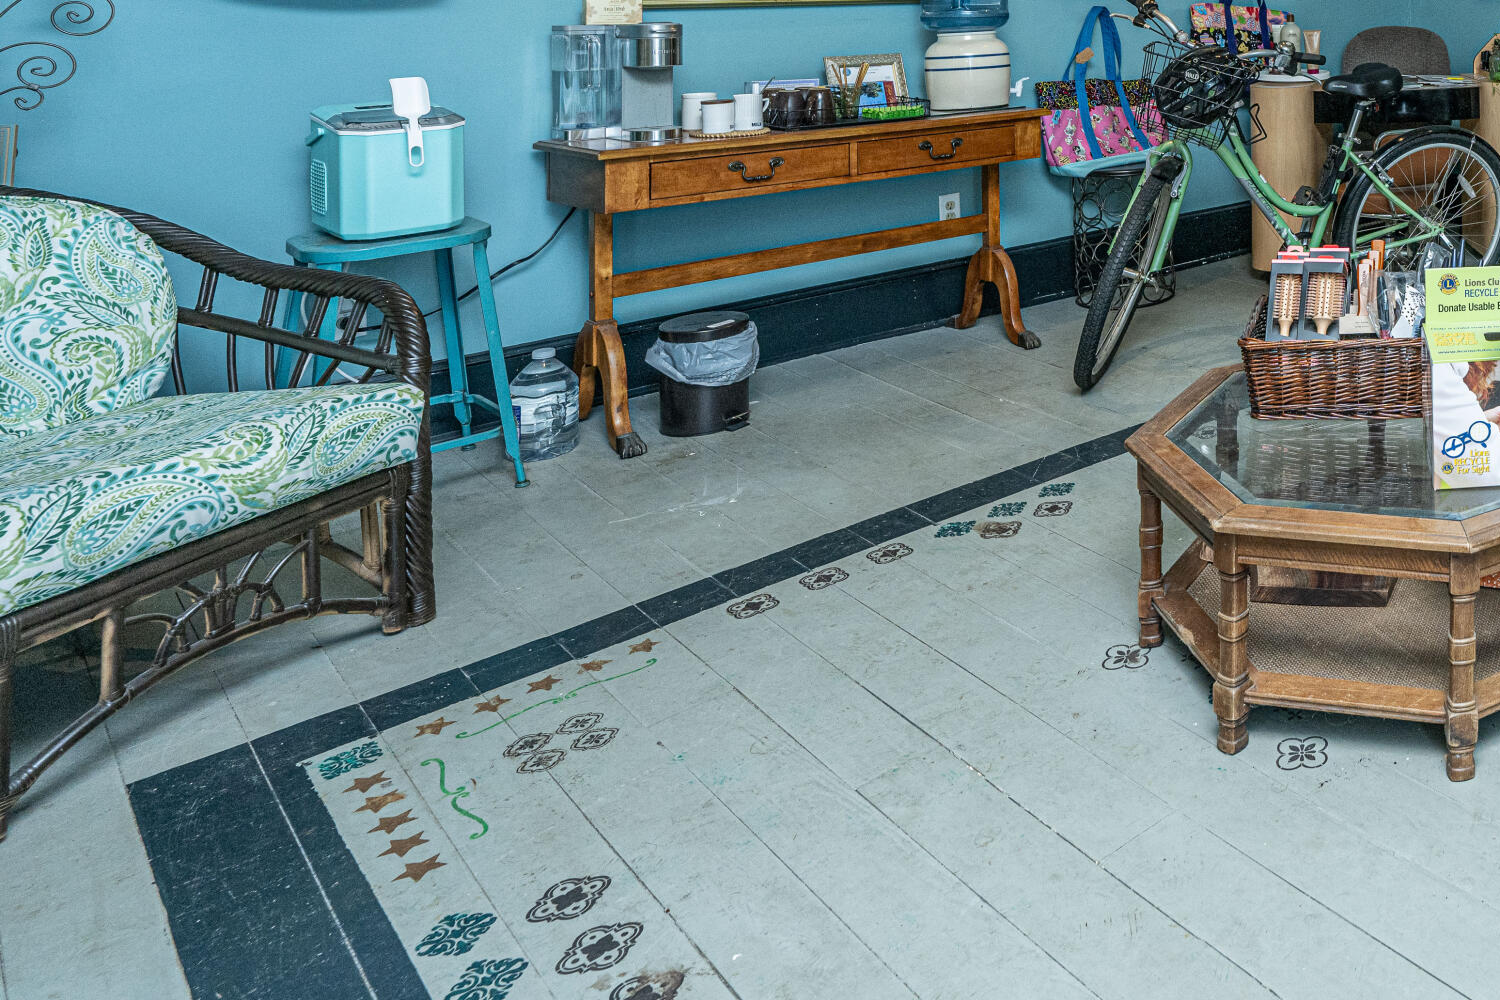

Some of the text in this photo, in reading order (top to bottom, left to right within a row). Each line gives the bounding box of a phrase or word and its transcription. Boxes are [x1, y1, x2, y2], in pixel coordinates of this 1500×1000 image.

[1464, 279, 1486, 287] Lions
[1464, 288, 1499, 298] RECYCLE
[1438, 303, 1467, 313] Donate
[1468, 302, 1495, 311] Usable
[1470, 449, 1490, 457] Lions
[1454, 457, 1490, 466] RECYCLE
[1457, 464, 1490, 475] For Sight
